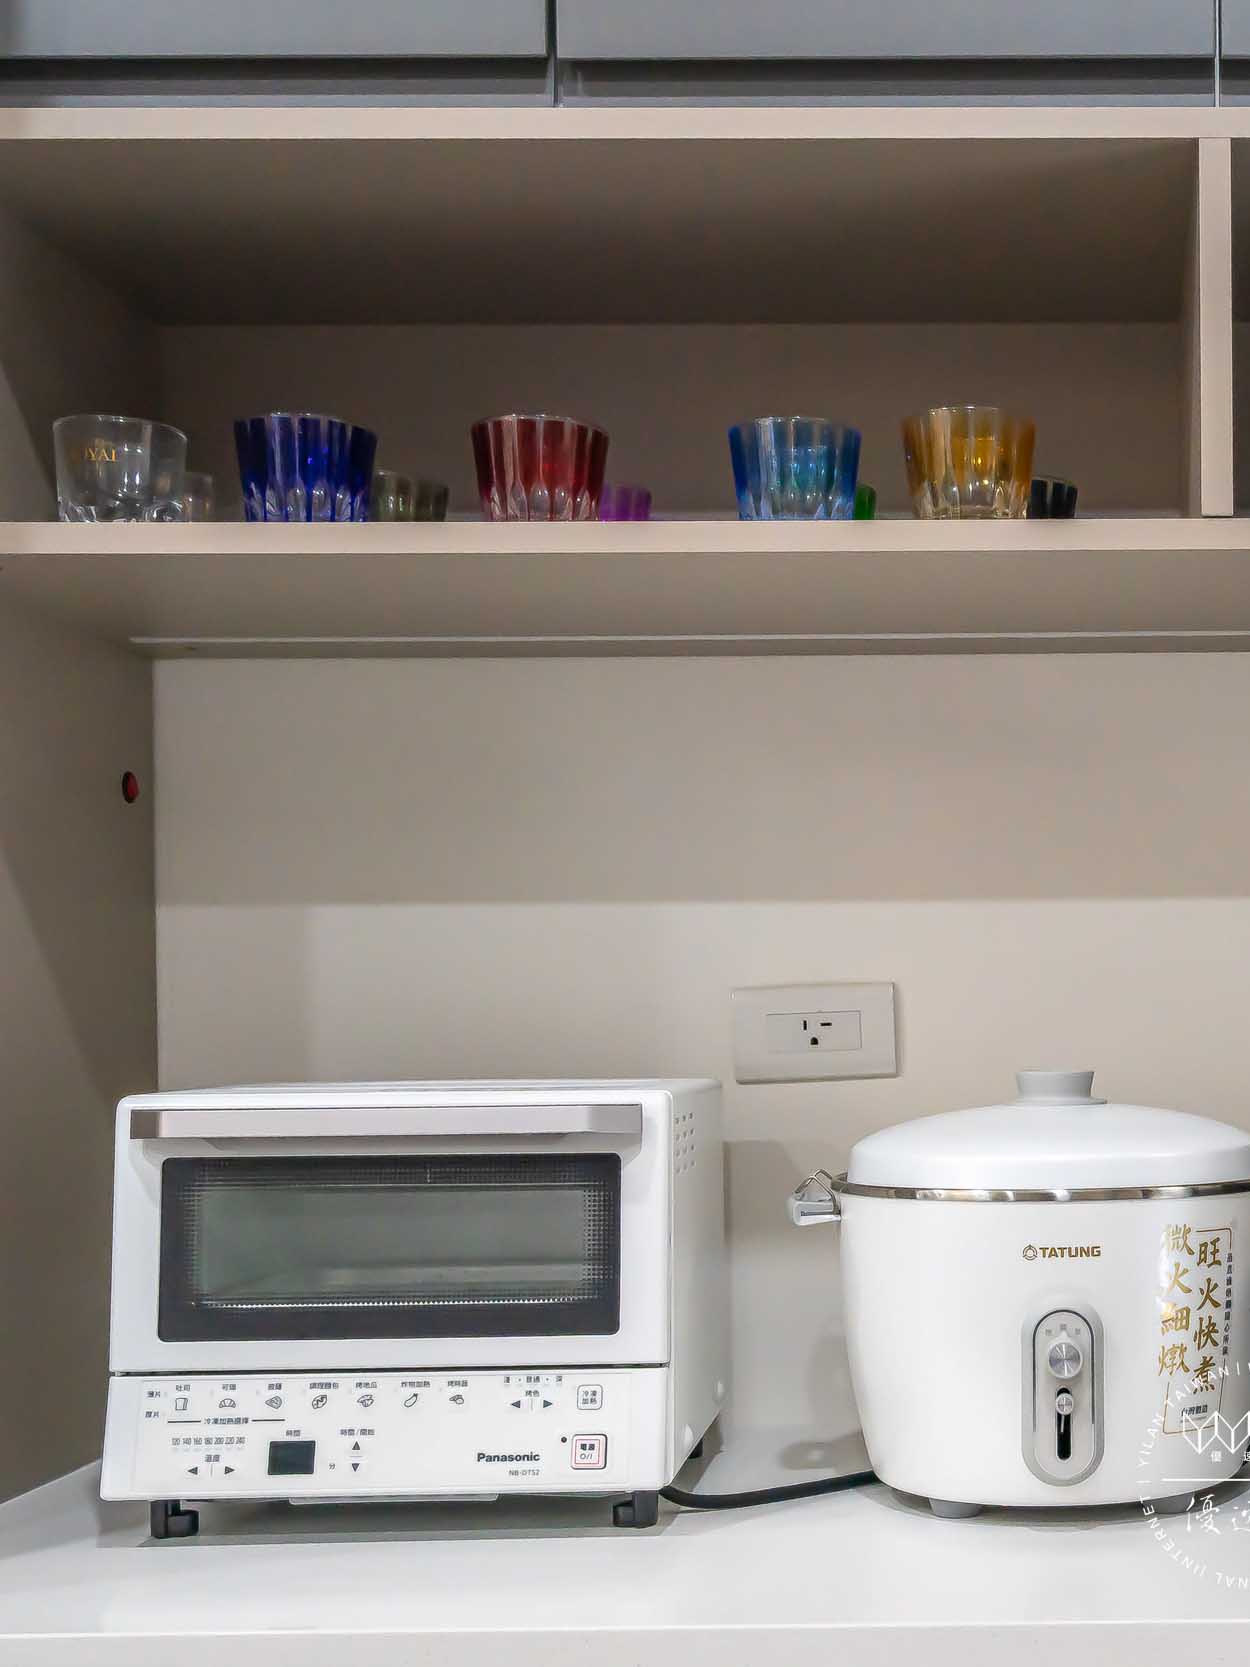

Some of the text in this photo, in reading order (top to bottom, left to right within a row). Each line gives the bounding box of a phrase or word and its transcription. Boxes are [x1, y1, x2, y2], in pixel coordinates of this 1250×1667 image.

[1039, 1245, 1101, 1258] TATUNG
[1193, 1237, 1222, 1394] 旺火快煮
[477, 1451, 540, 1463] Panasonic
